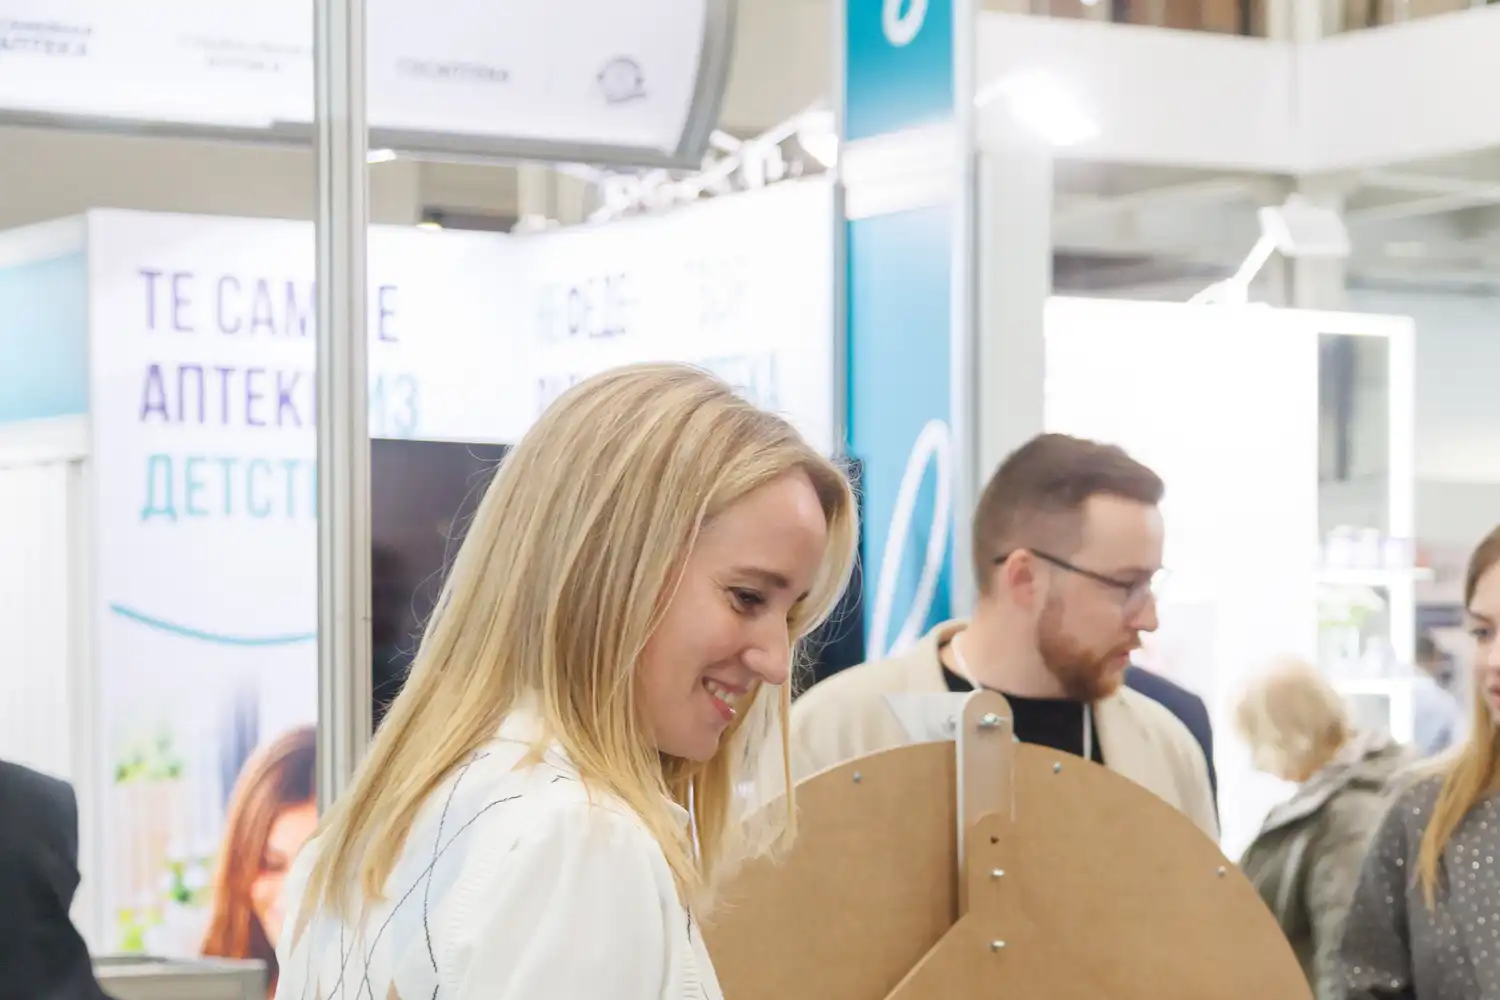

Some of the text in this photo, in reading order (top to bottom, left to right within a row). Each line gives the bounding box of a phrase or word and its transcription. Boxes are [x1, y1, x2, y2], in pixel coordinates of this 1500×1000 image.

[139, 268, 400, 342] ТЕ САМЕ
[139, 363, 317, 427] АПТЕК
[139, 453, 317, 522] ДЕТСТ
